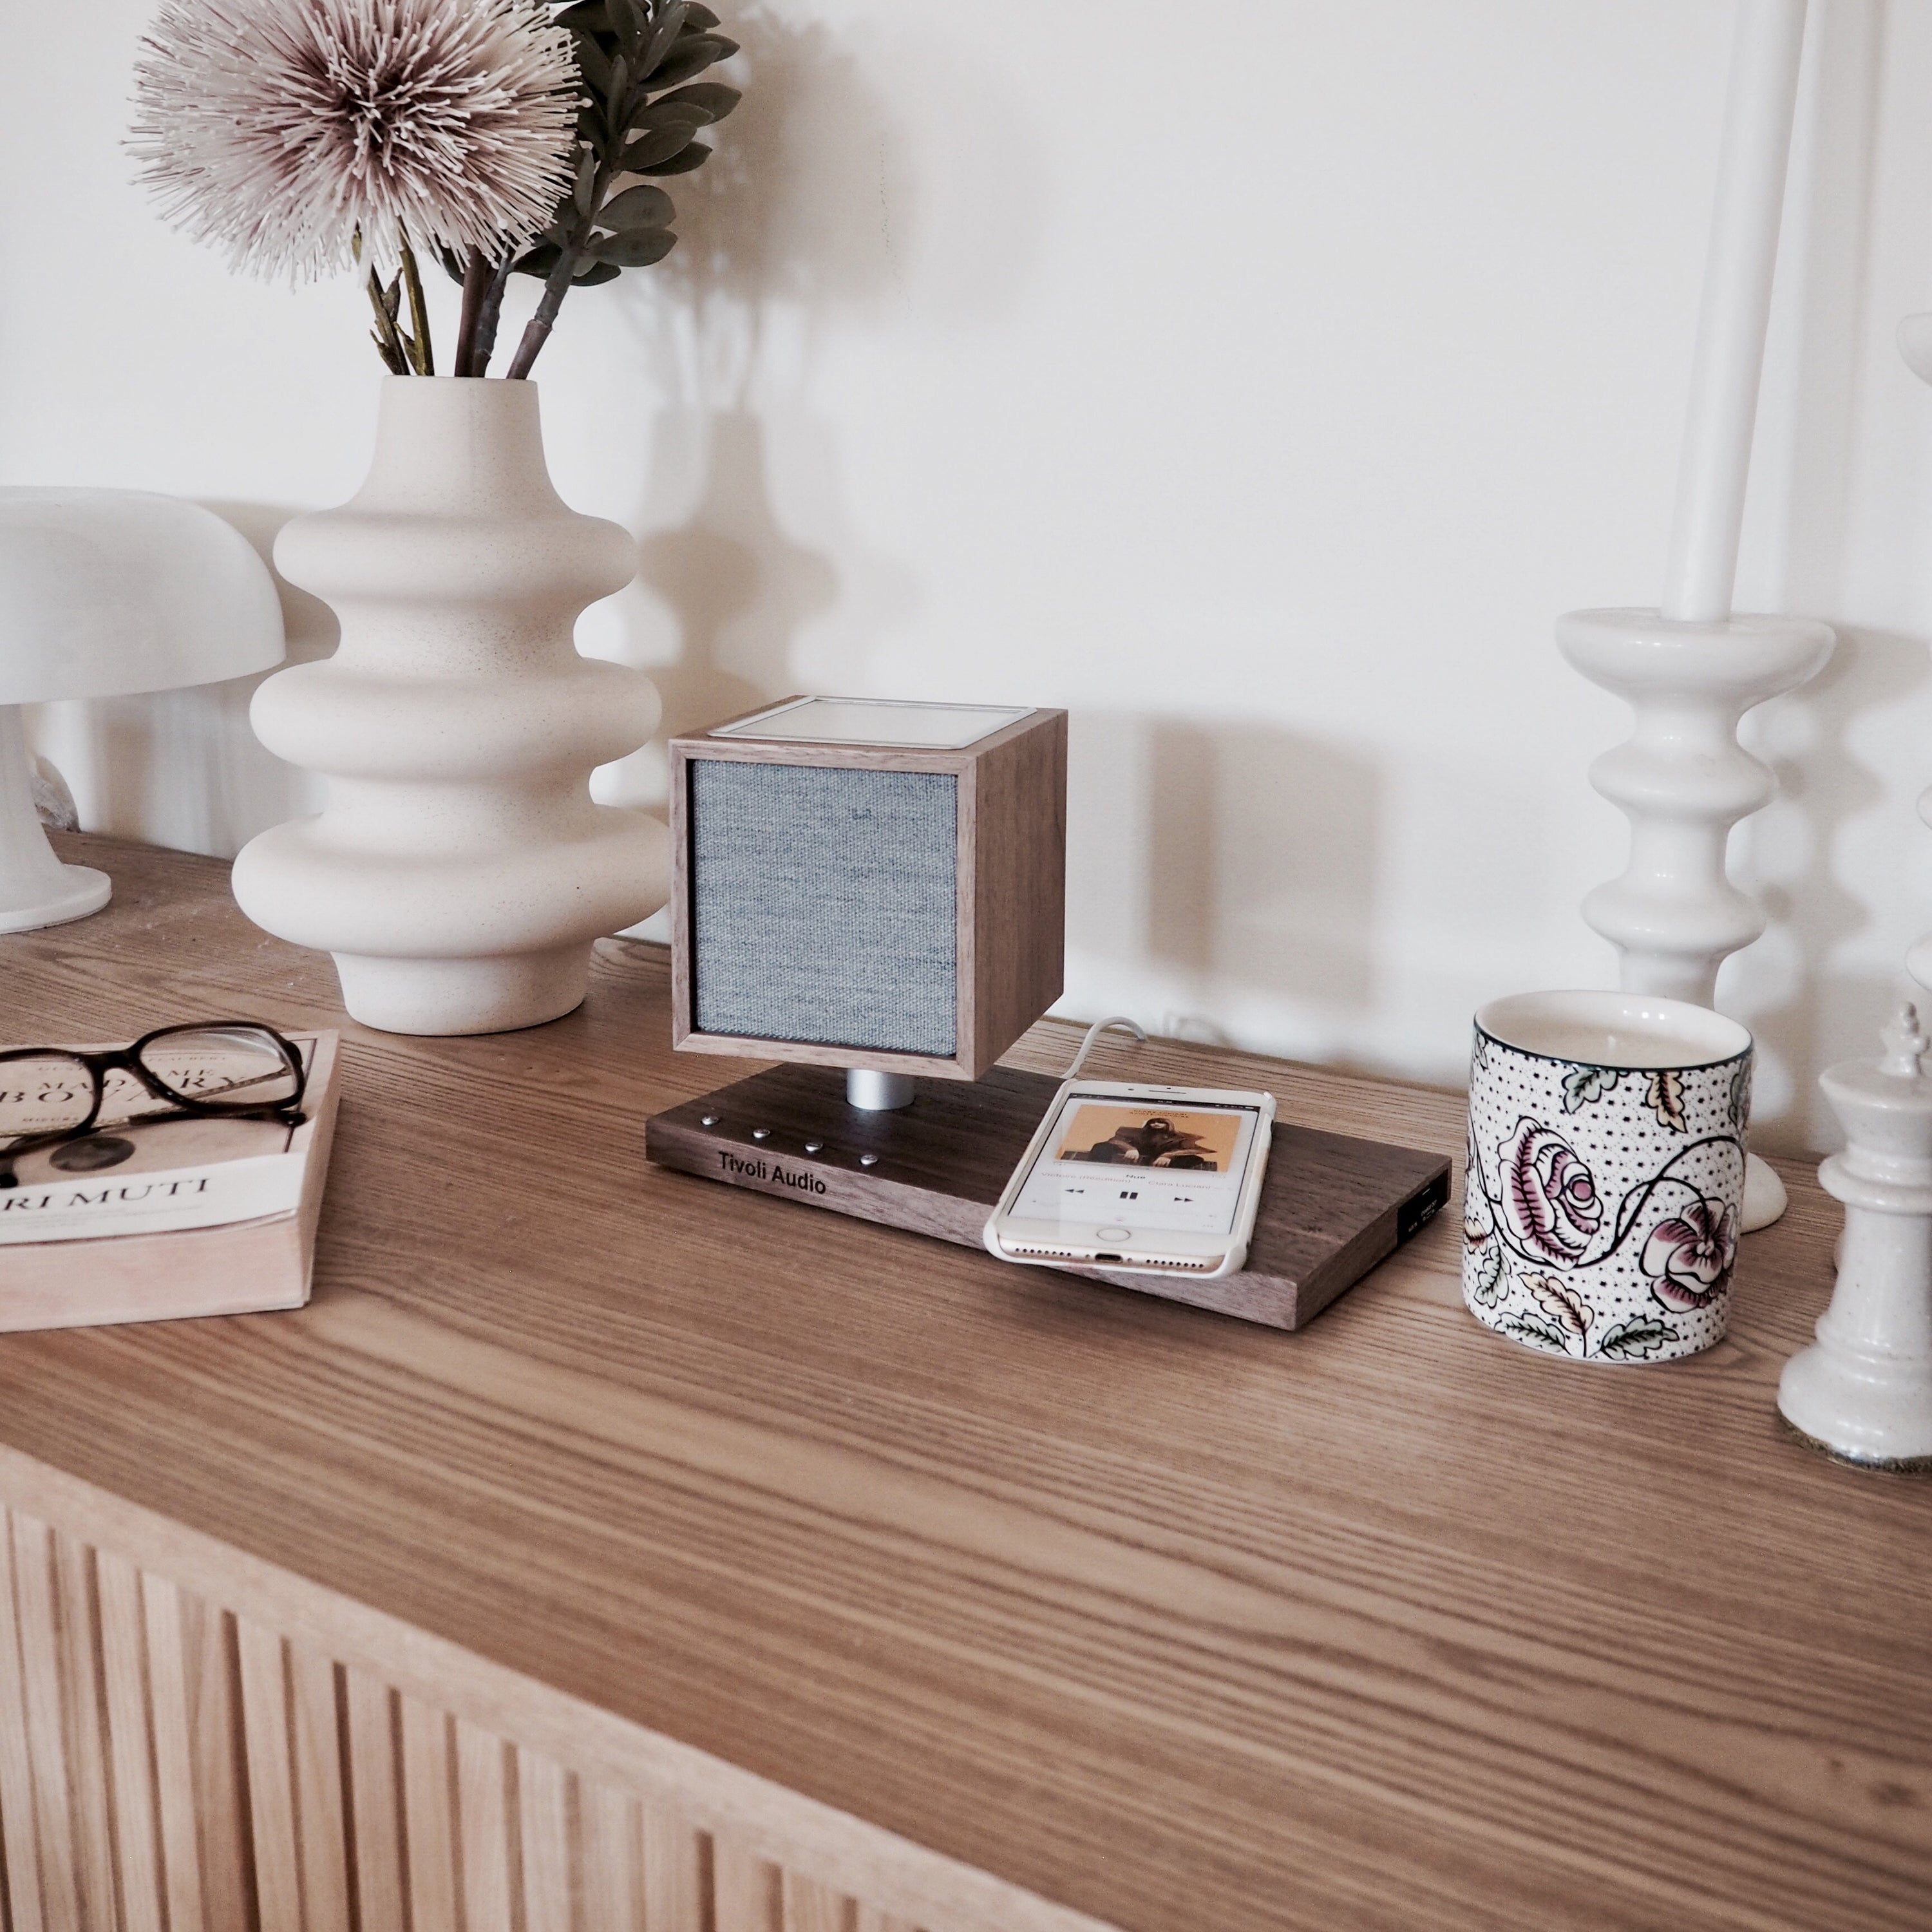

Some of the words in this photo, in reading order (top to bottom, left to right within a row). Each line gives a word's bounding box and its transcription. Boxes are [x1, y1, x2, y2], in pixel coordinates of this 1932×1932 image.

[38, 1069, 215, 1090] MADME
[718, 1151, 766, 1179] Tivoli
[772, 1166, 826, 1195] Audio
[67, 1177, 211, 1207] MUTI
